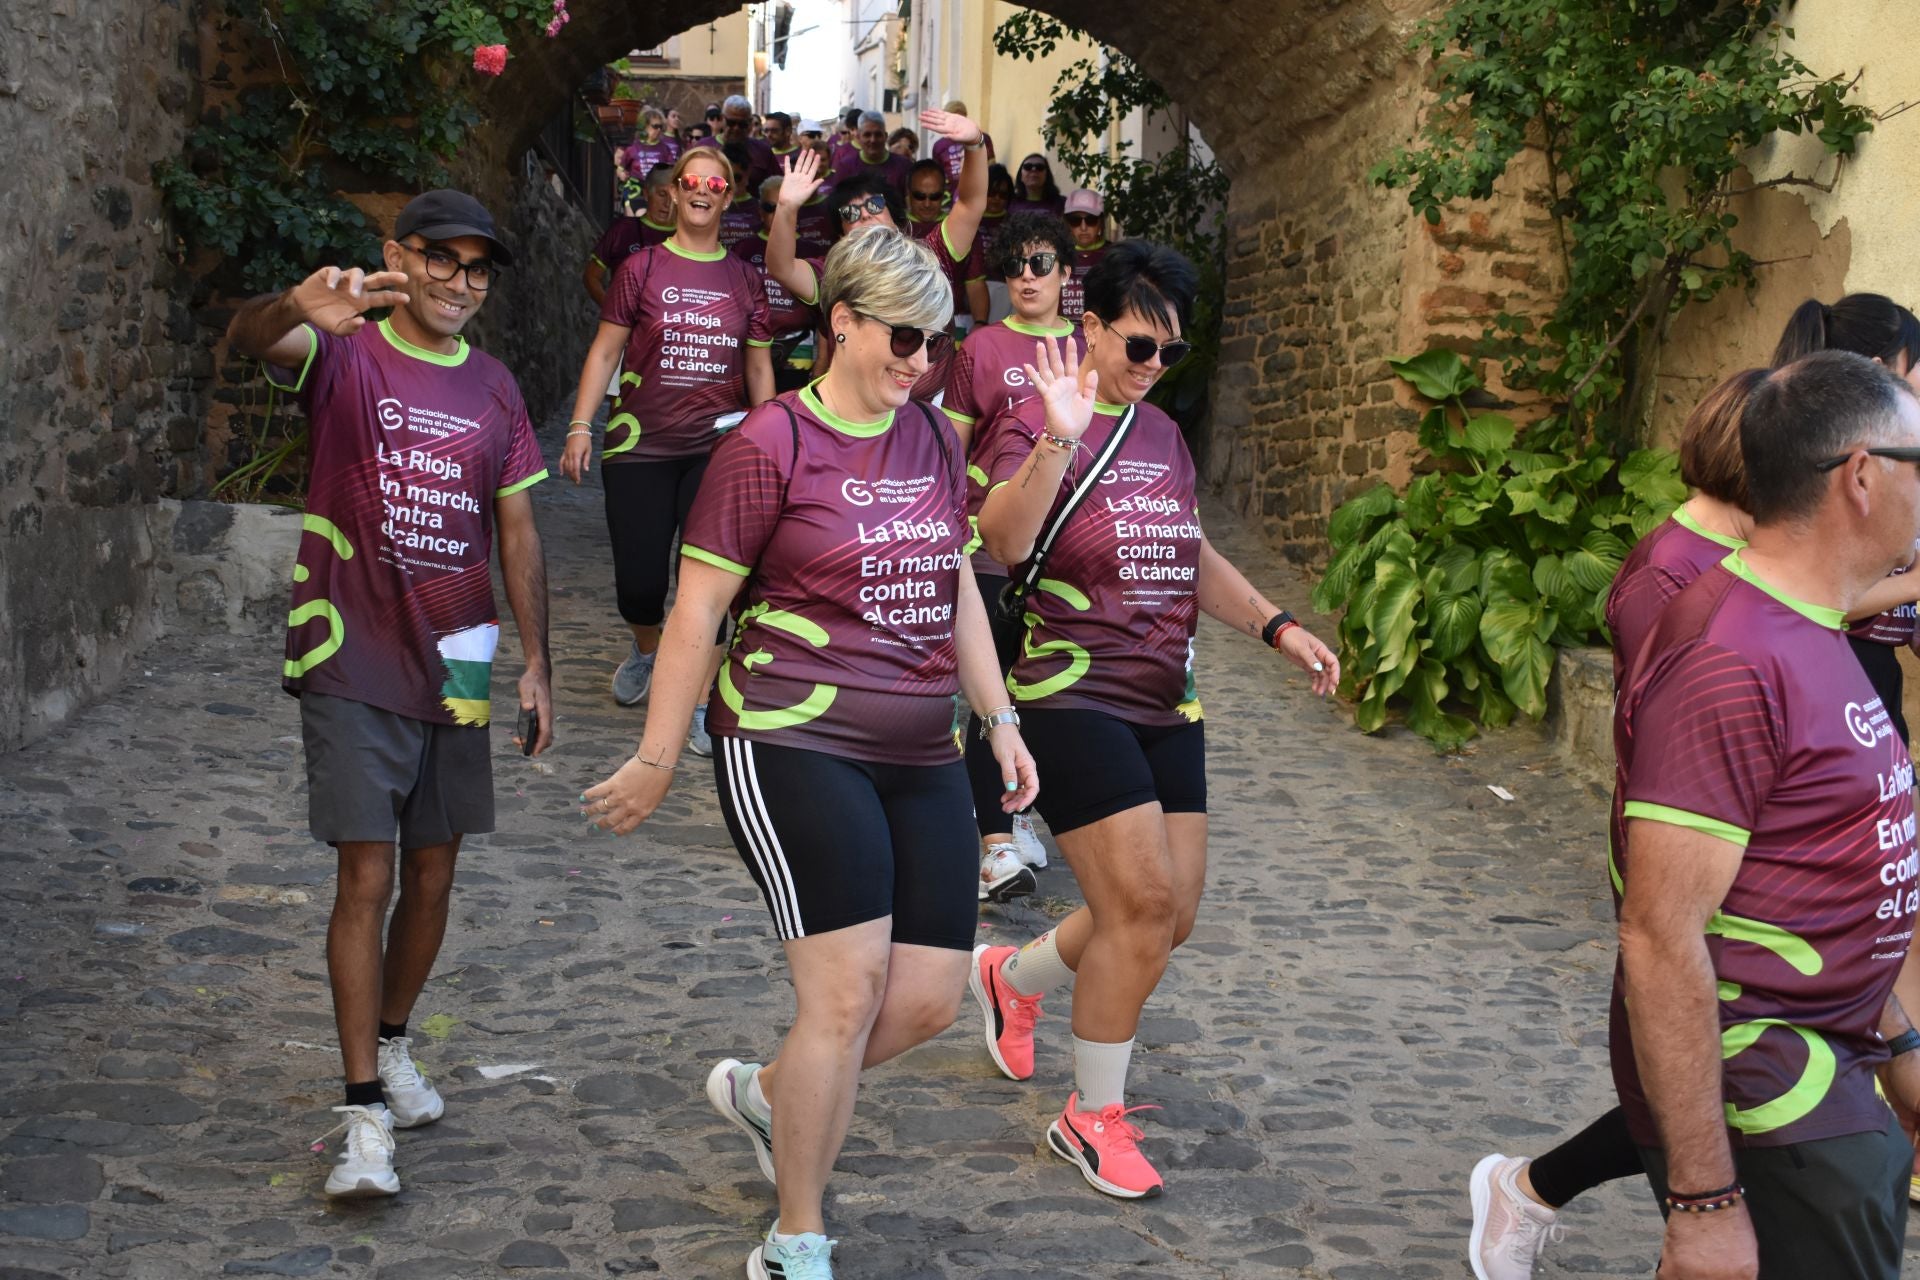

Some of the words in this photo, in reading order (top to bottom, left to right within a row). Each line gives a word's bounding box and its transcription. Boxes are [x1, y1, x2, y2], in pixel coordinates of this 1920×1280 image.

[765, 287, 782, 296] tra
[1062, 298, 1084, 306] cont
[663, 311, 682, 323] La
[685, 312, 721, 329] Rioja
[663, 329, 681, 341] En
[684, 332, 738, 348] marcha
[661, 345, 709, 358] contra
[660, 356, 675, 369] el
[677, 359, 728, 374] cáncer
[408, 406, 449, 420] asociación
[449, 414, 481, 429] española
[408, 415, 433, 426] contra
[443, 421, 467, 433] cáncer
[408, 424, 418, 432] en
[419, 424, 429, 434] La
[430, 427, 449, 438] Rioja
[378, 441, 403, 467] La
[408, 450, 462, 481] Rioja
[887, 495, 897, 503] La
[896, 495, 918, 504] Rioja
[896, 487, 904, 495] el
[904, 485, 930, 495] cáncer
[1105, 496, 1133, 513] La
[1133, 495, 1181, 516] Rioja
[857, 522, 891, 544] La
[892, 517, 951, 543] Rioja
[1114, 520, 1141, 538] En
[1144, 520, 1201, 539] marcha
[1117, 541, 1176, 560] contra
[860, 555, 893, 578] En
[898, 547, 963, 574] march
[1118, 561, 1139, 580] el
[1140, 561, 1195, 581] cáncer
[859, 578, 936, 603] contra
[862, 604, 887, 625] el
[888, 602, 952, 625] cáncer
[1877, 773, 1897, 804] La
[1893, 758, 1913, 796] Rioja
[1876, 818, 1904, 850] En
[1879, 847, 1919, 886] cont
[1876, 888, 1903, 920] el
